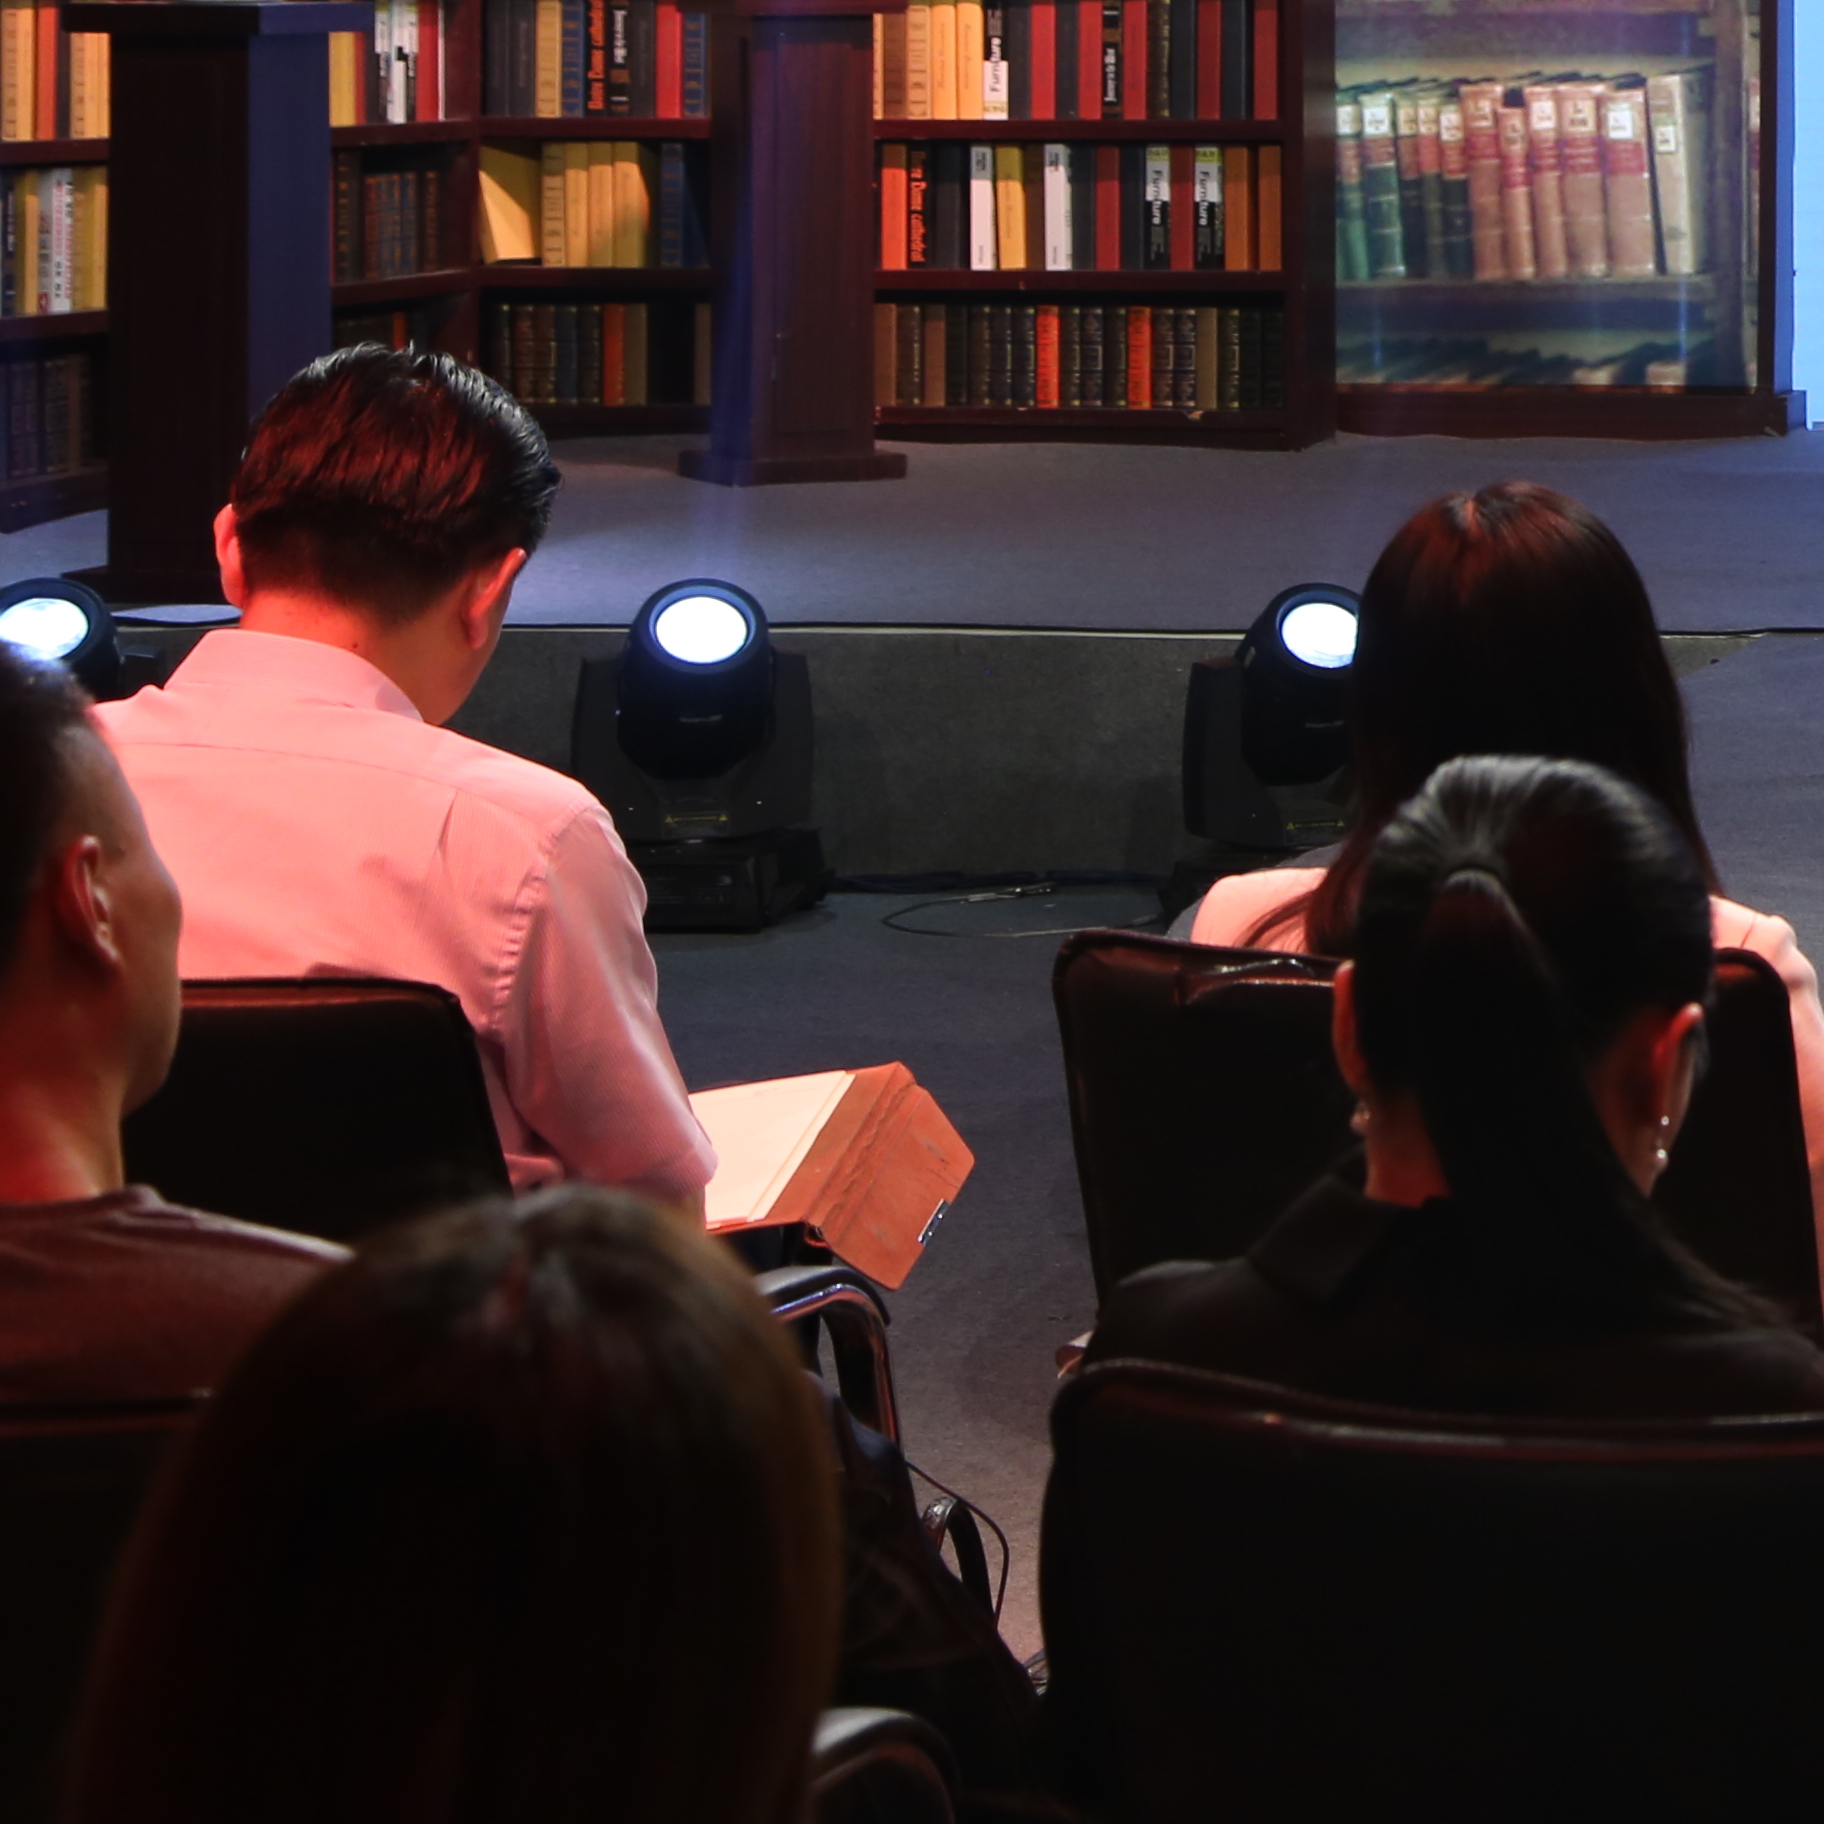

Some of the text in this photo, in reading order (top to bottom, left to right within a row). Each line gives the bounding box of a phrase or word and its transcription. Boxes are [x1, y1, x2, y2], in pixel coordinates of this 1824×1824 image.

[988, 37, 1001, 93] Furniture
[1151, 169, 1163, 225] Furniture
[1198, 170, 1210, 226] Furniture
